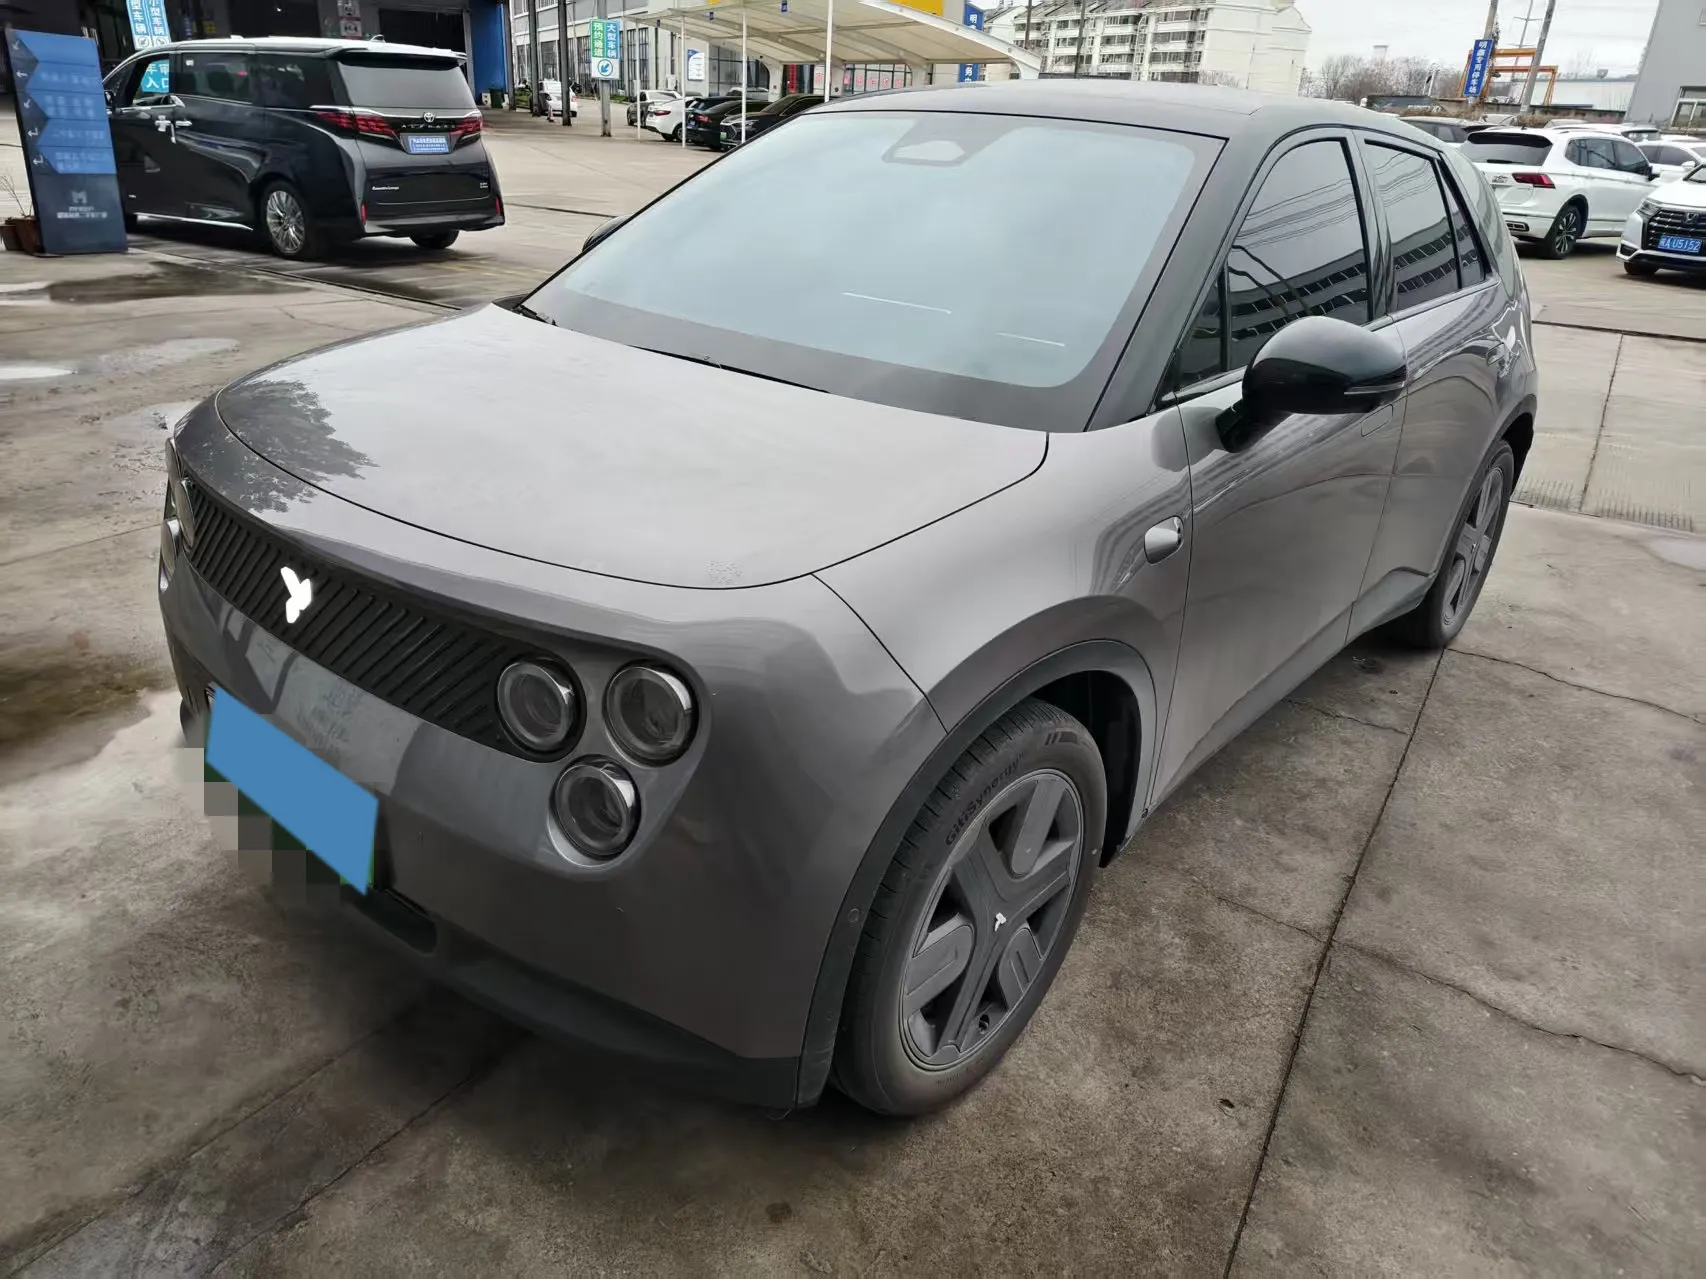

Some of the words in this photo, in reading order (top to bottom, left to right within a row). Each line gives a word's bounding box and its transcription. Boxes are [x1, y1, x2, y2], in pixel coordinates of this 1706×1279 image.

[606, 23, 617, 58] 大型车辆
[146, 77, 169, 89] 入口
